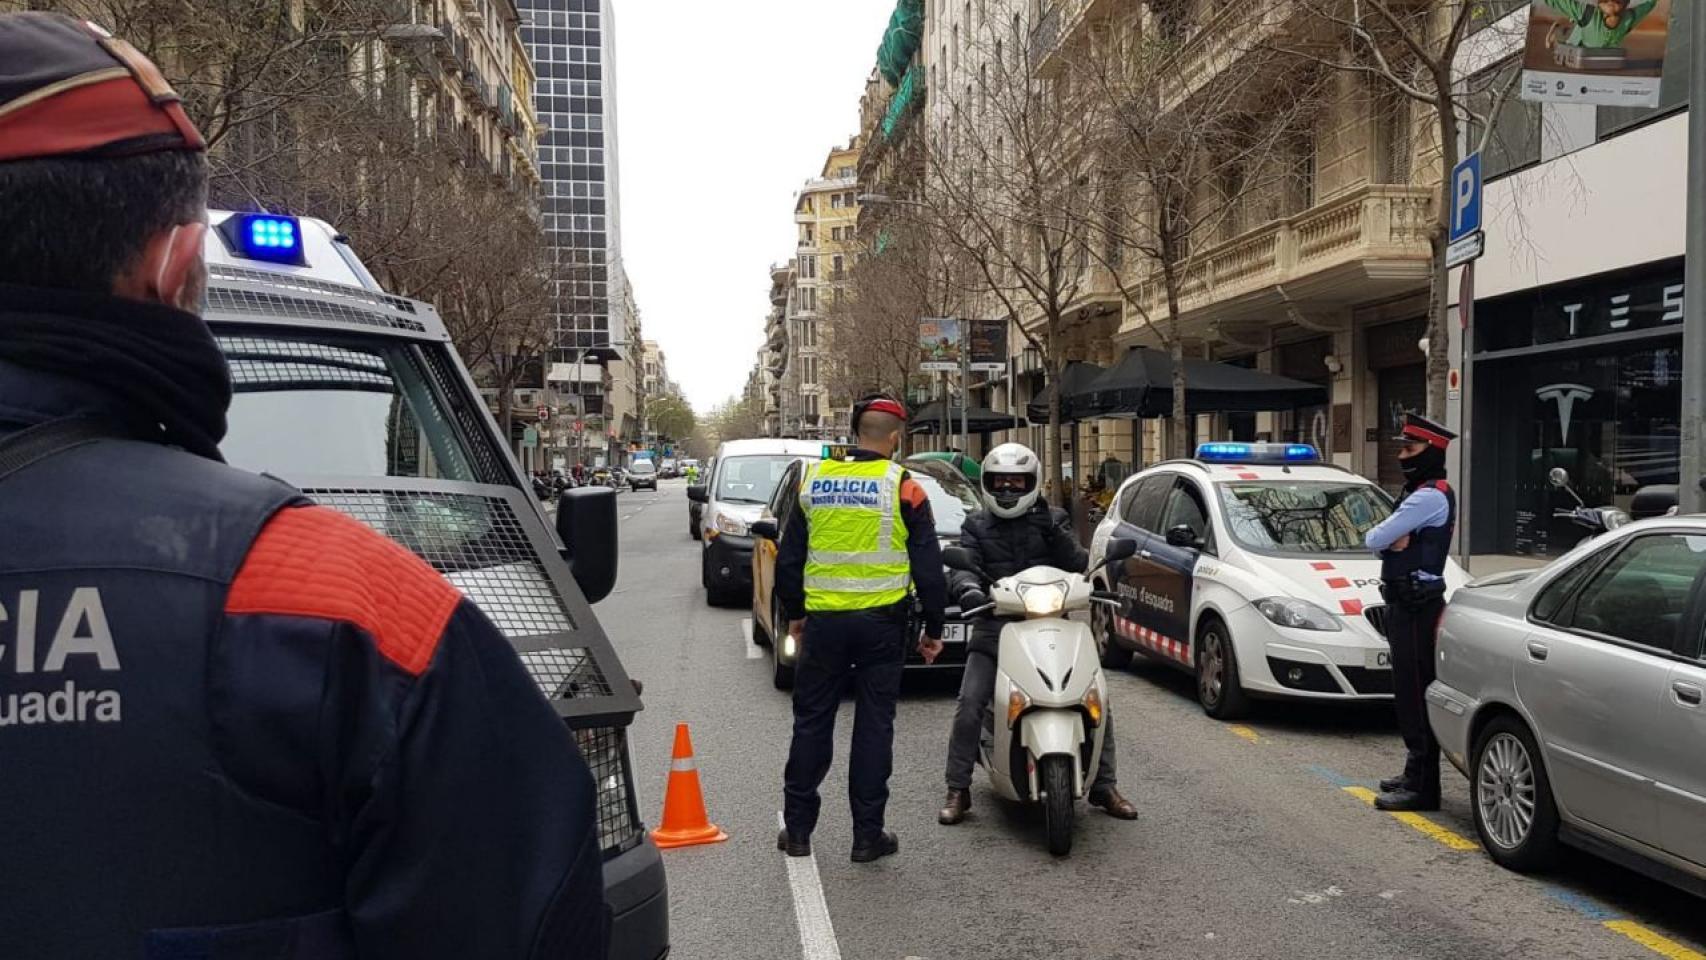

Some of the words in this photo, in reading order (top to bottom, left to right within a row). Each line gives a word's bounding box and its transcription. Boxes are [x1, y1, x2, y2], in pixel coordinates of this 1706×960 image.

[1456, 168, 1474, 231] P
[812, 479, 879, 493] POLICIA
[0, 587, 121, 673] IA
